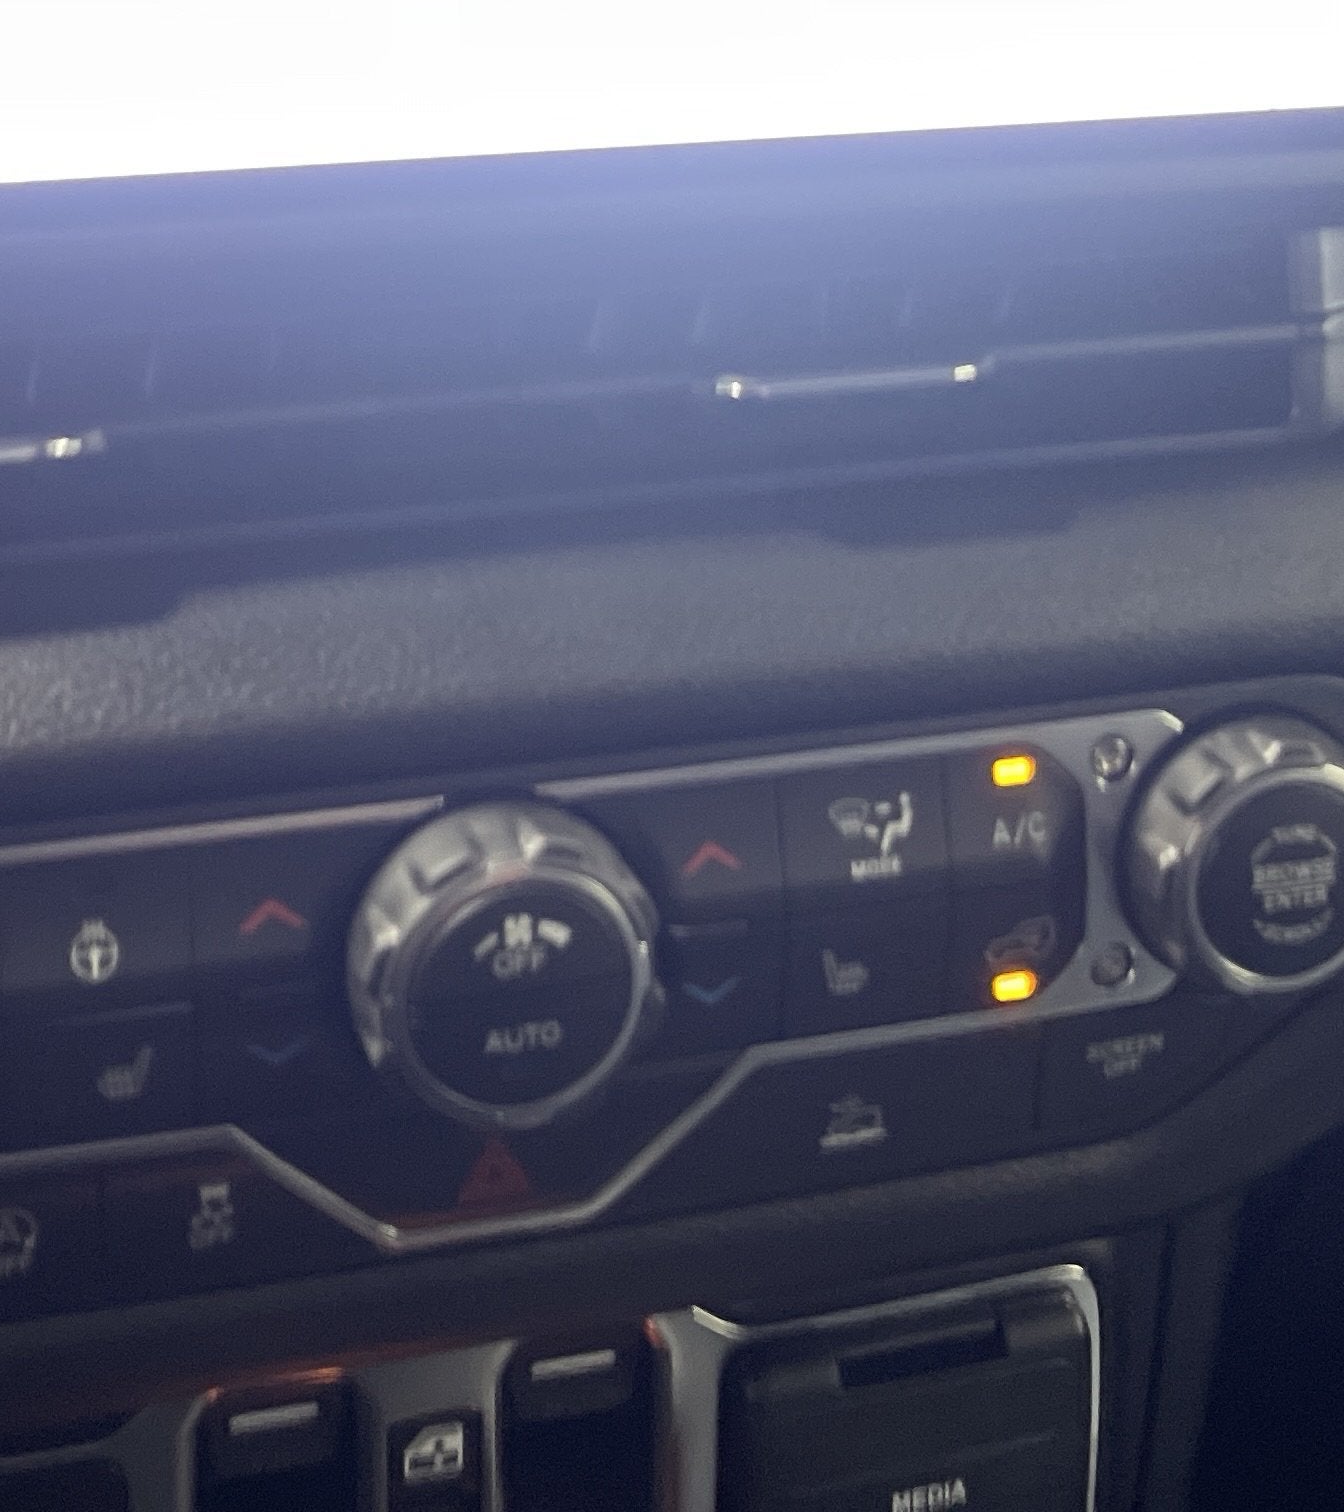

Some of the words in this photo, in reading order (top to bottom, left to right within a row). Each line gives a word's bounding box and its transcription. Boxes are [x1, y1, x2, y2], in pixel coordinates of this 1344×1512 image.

[992, 811, 1047, 848] A/C
[484, 1020, 564, 1054] AUTO
[892, 1478, 967, 1512] MEDIA
